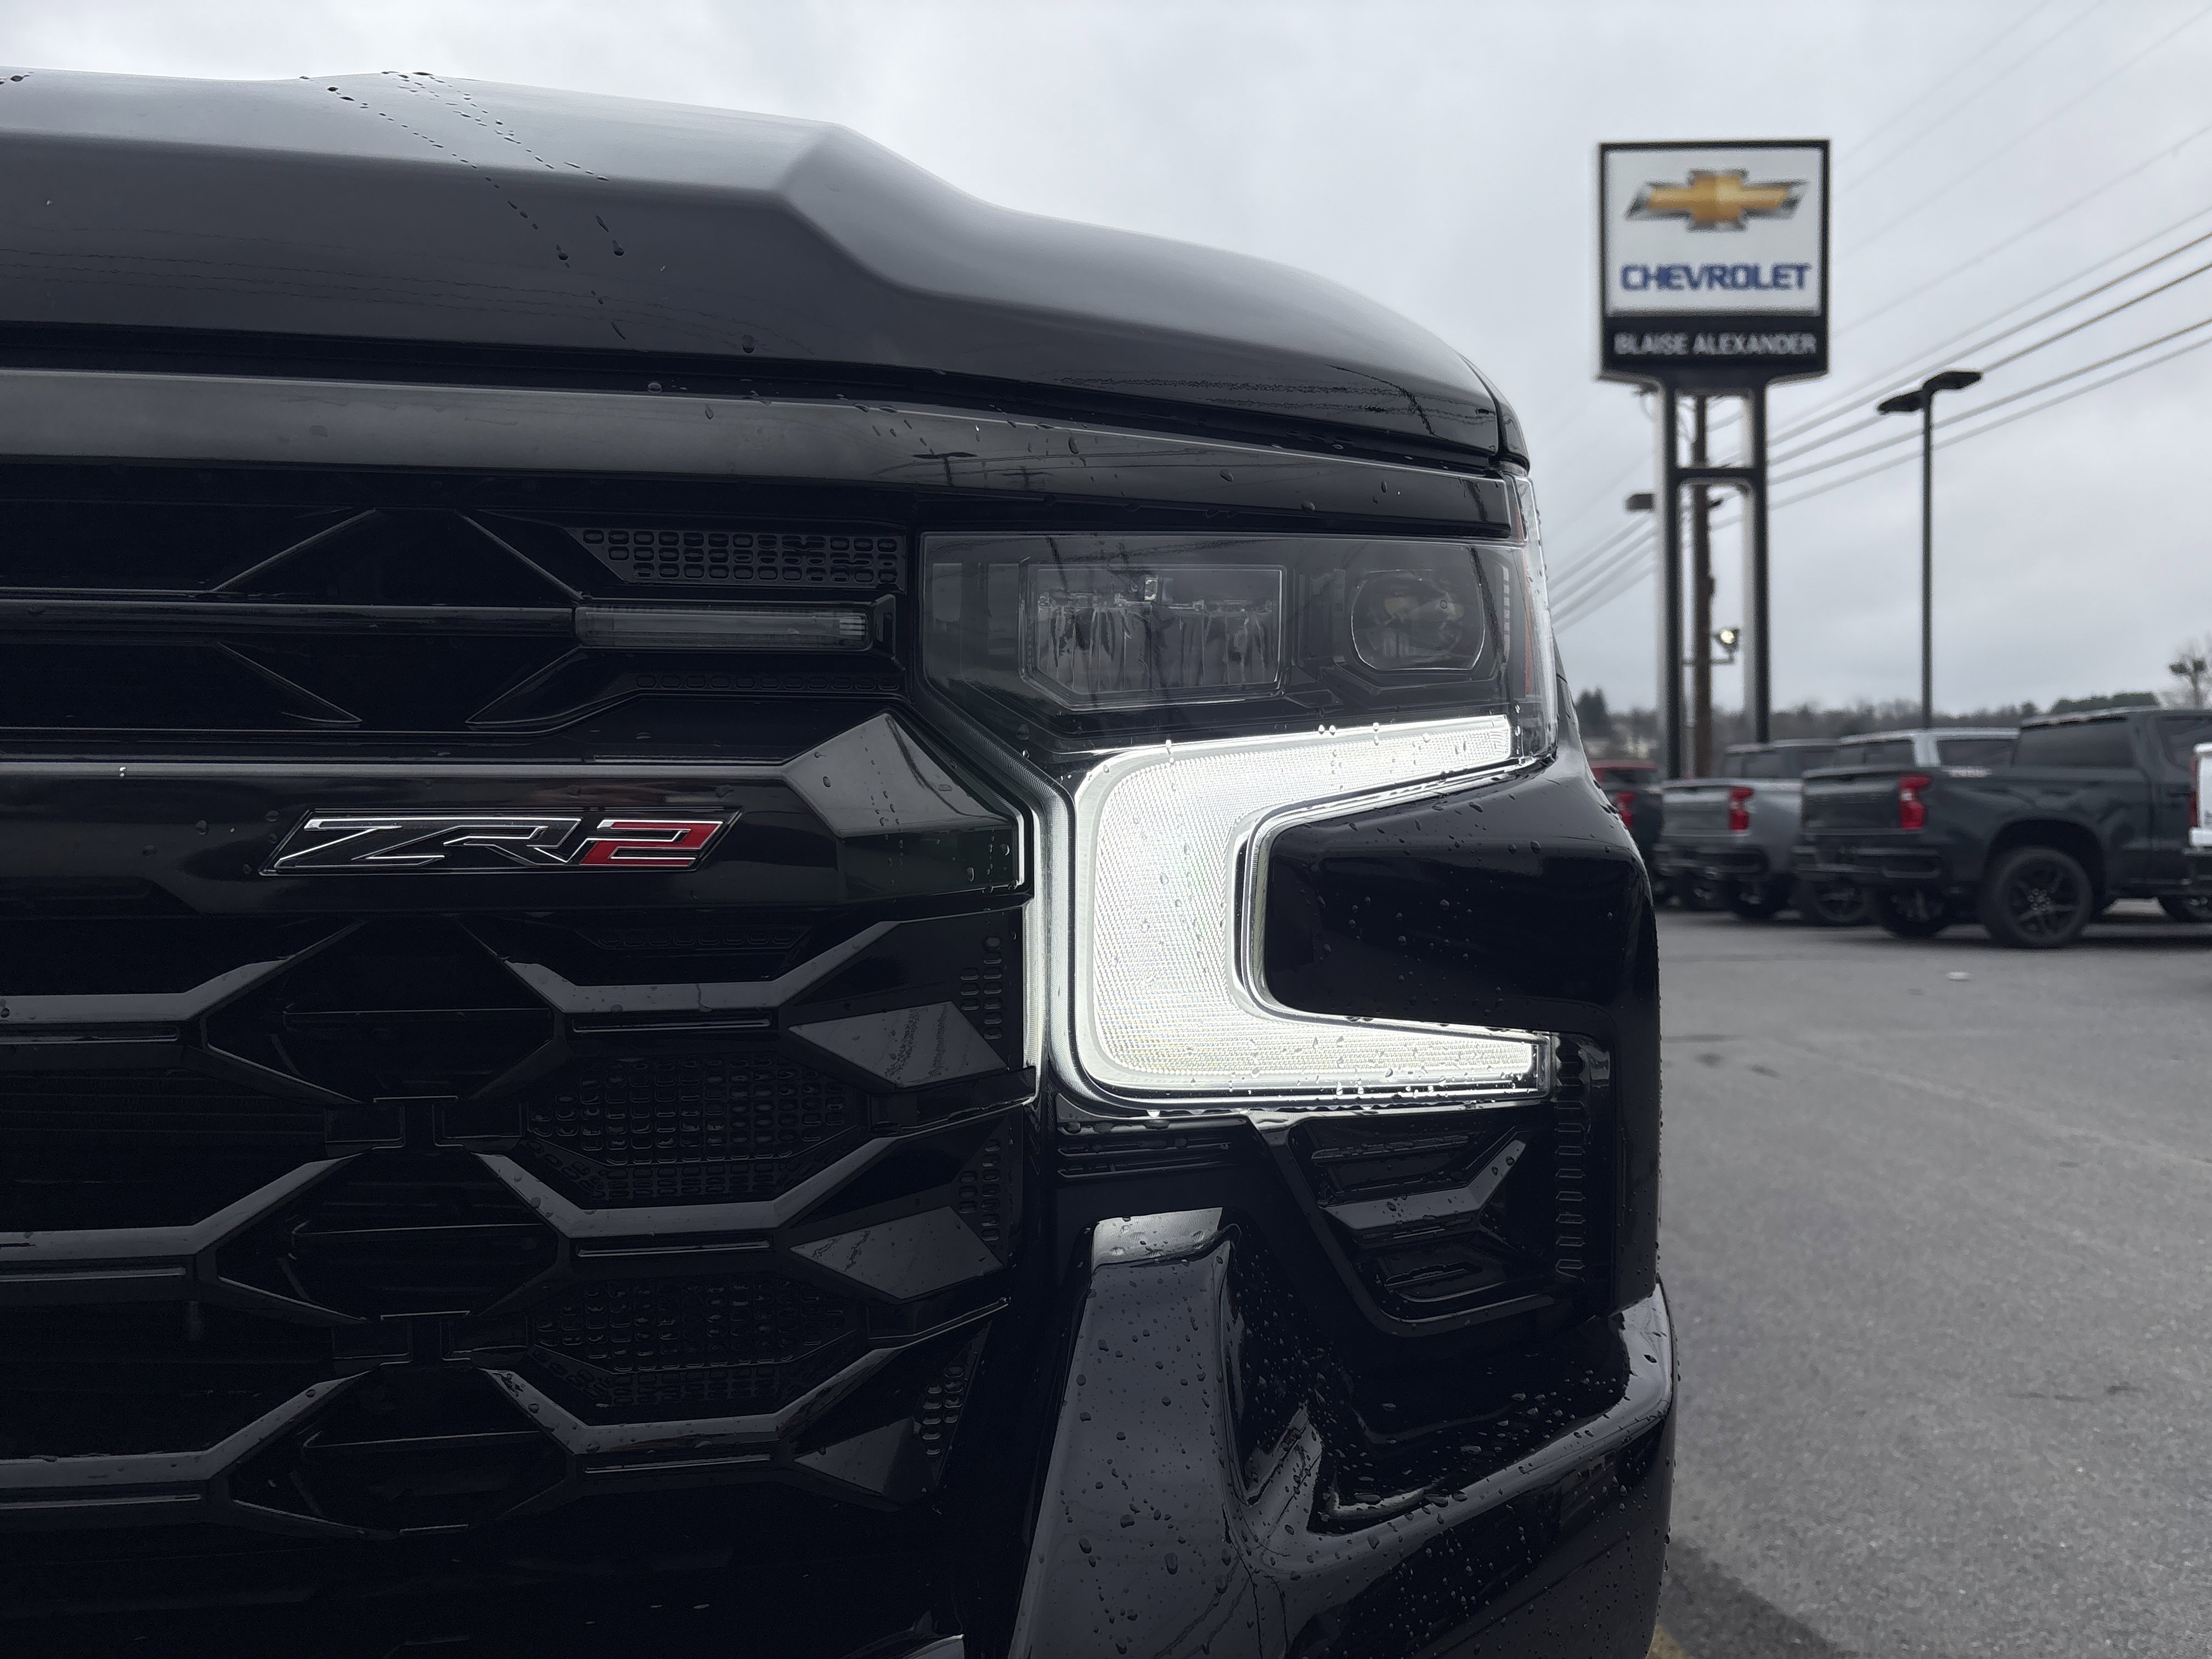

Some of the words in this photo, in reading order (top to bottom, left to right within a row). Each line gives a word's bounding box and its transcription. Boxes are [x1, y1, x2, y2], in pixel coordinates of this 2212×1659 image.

[1621, 262, 1812, 290] CHEVROLET
[1613, 331, 1689, 356] BLAISE
[1692, 331, 1817, 356] ALEXANDER
[274, 817, 725, 867] ZR2
